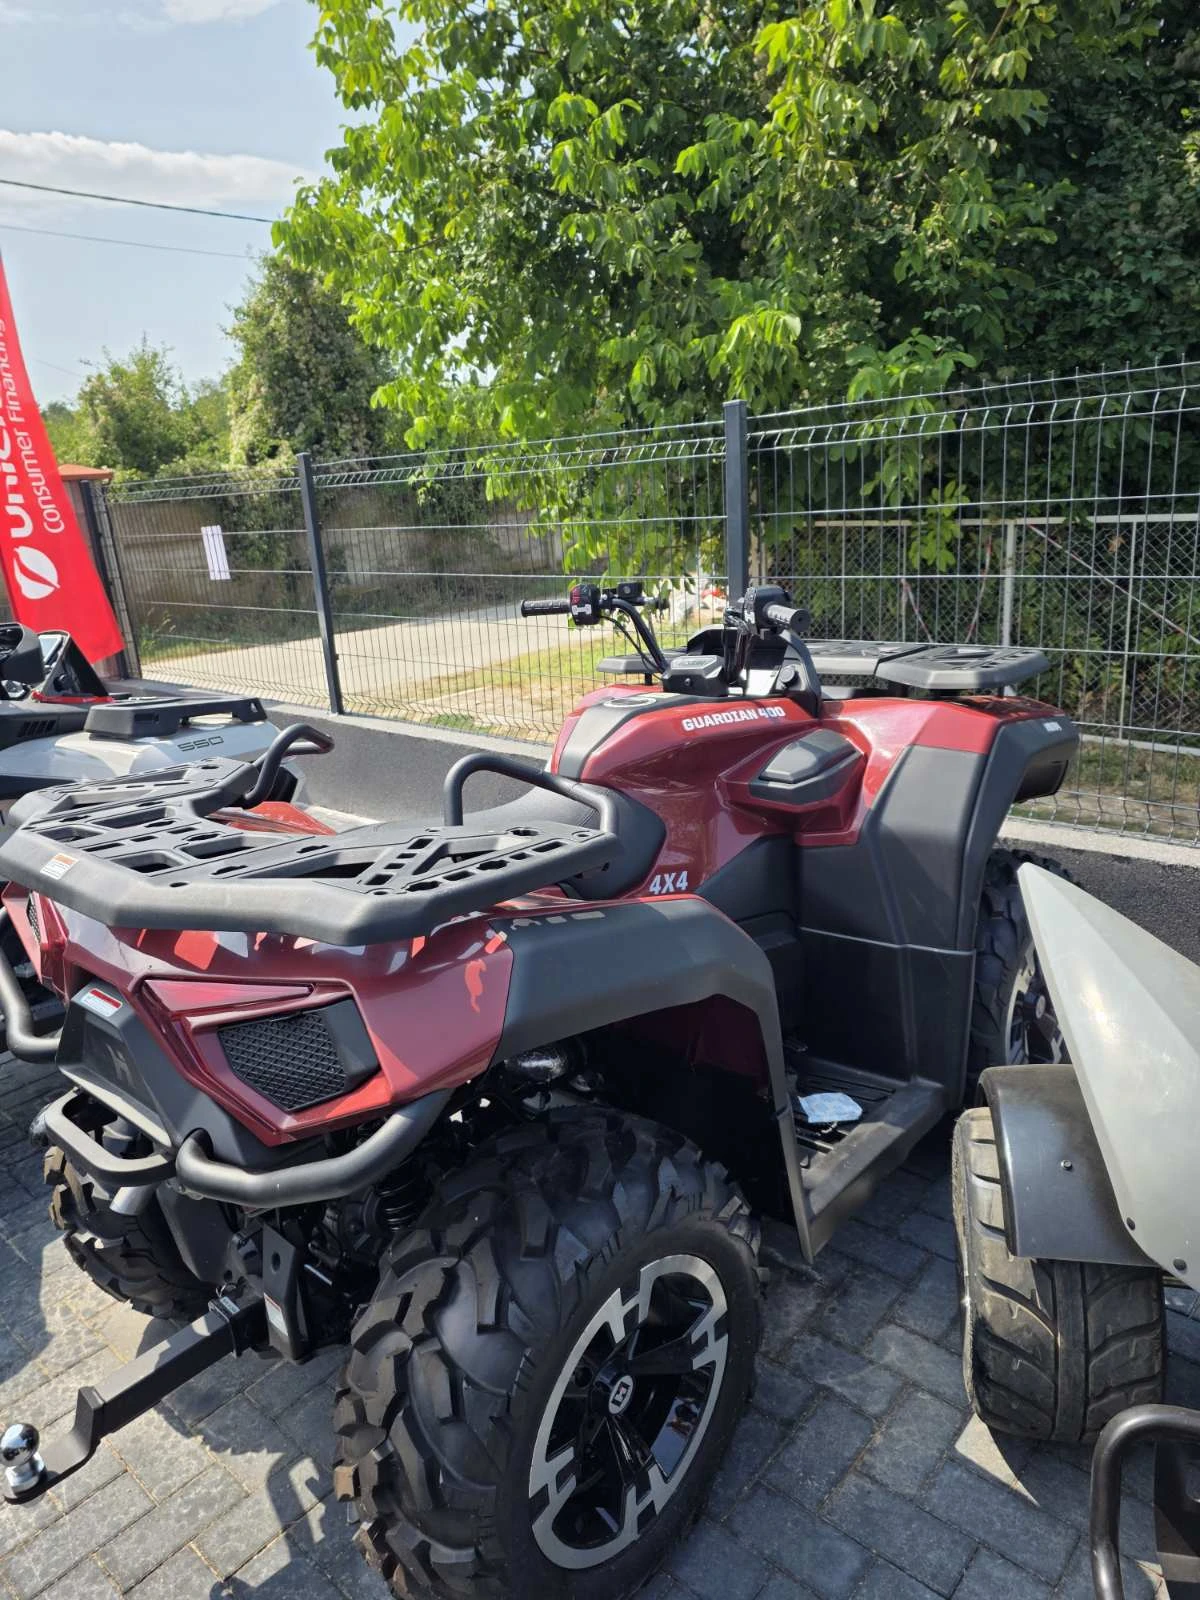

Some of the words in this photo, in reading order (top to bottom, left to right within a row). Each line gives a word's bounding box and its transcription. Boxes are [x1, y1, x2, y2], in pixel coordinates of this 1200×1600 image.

[14, 428, 65, 533] Consumer
[681, 709, 758, 732] GUARDIAN
[759, 706, 786, 719] 400
[177, 736, 224, 752] 550
[649, 871, 688, 895] 4X4
